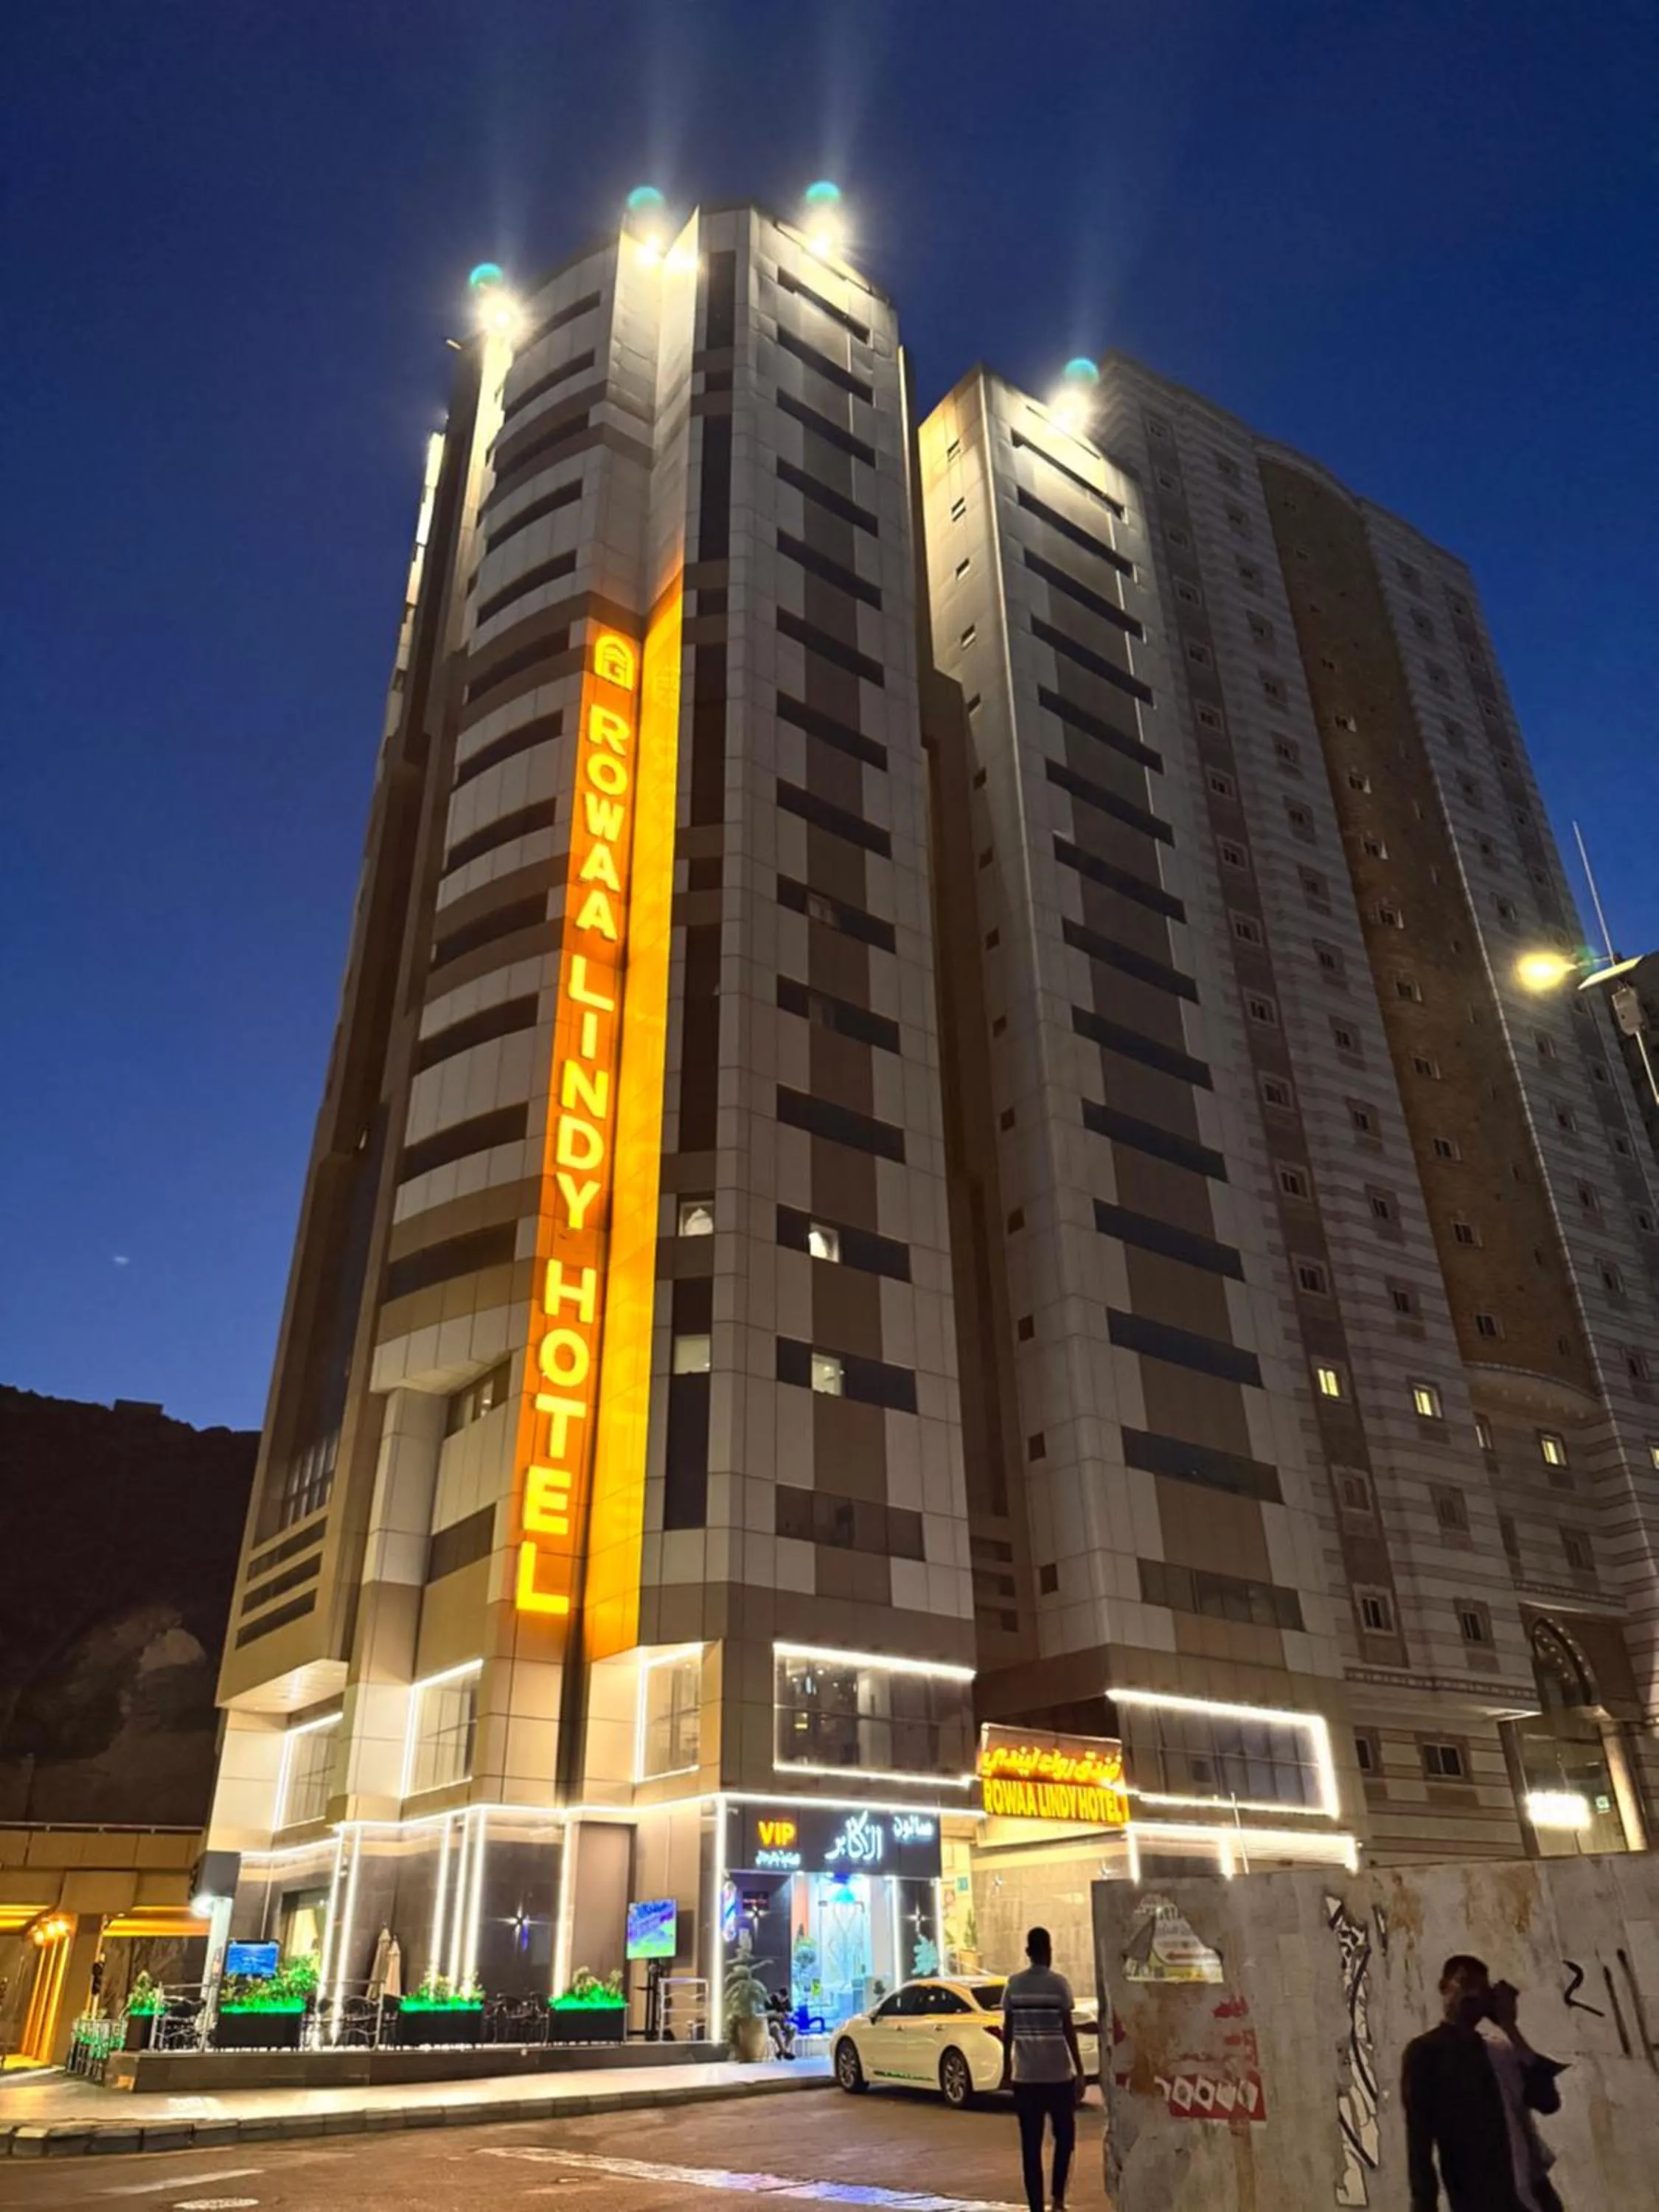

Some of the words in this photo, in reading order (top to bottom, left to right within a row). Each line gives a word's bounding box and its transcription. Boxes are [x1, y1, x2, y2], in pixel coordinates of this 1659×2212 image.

[575, 704, 631, 941] ROWAA
[555, 955, 614, 1230] LINDY
[515, 1258, 597, 1615] HOTEL
[757, 1820, 796, 1846] VIP
[984, 1778, 1039, 1816] ROWAA
[1038, 1782, 1077, 1818] LINDY
[1077, 1786, 1123, 1823] HOTEL
